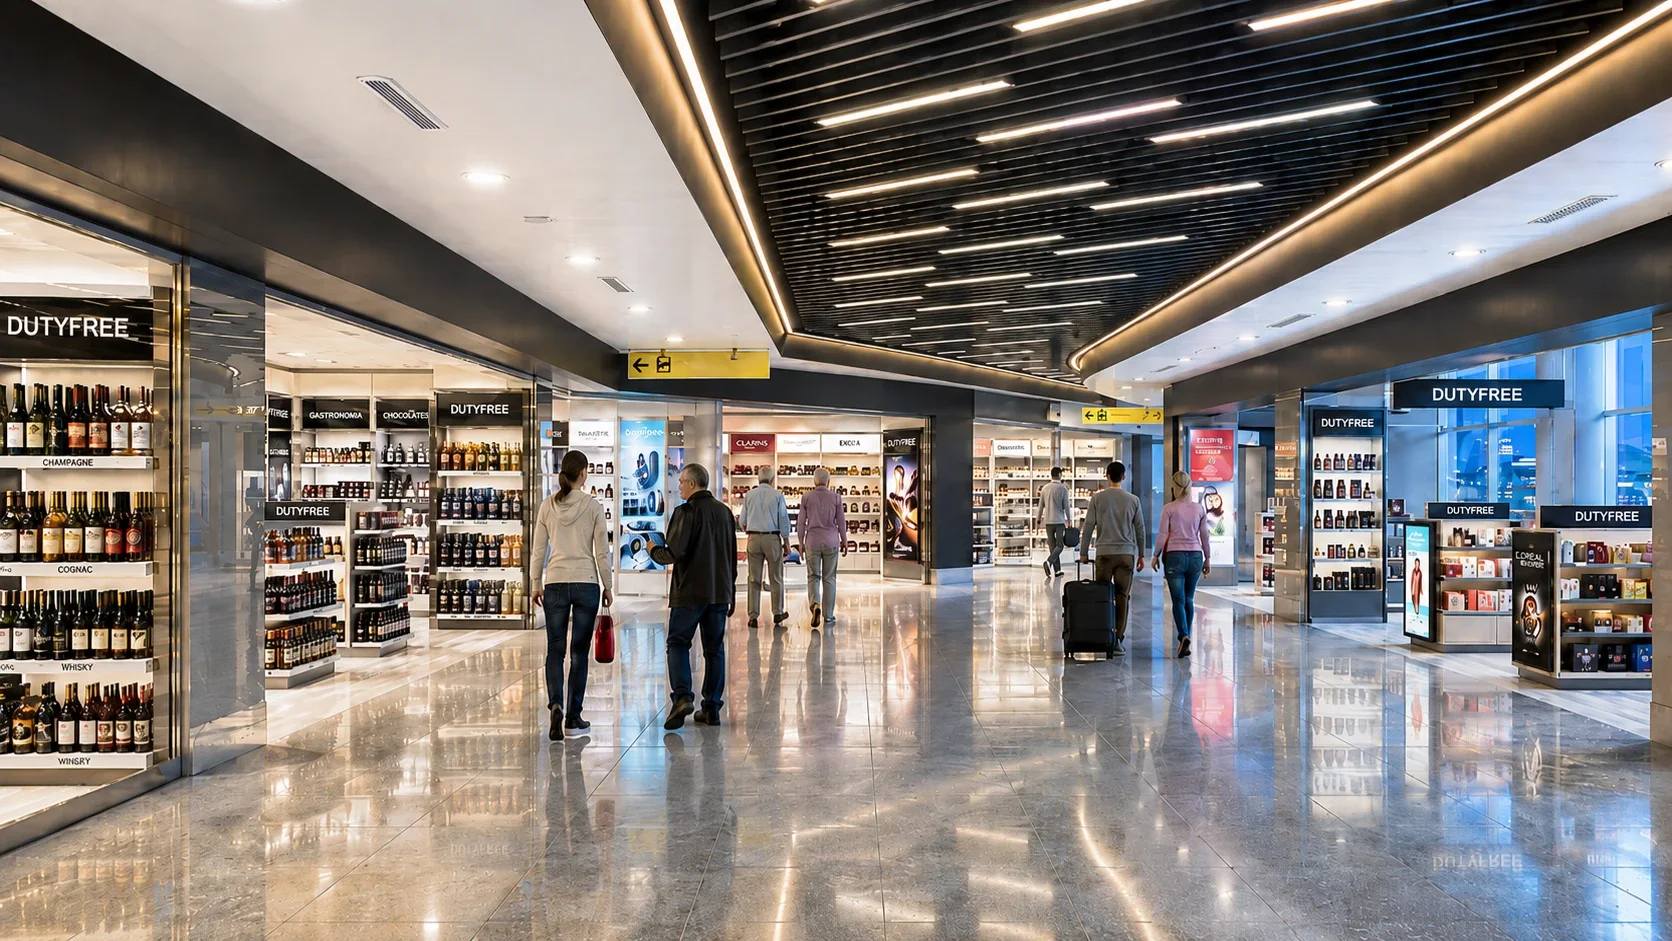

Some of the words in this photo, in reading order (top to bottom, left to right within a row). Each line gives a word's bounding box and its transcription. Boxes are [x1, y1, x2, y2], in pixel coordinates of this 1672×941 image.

[7, 316, 130, 338] DUTYFREE
[1432, 387, 1523, 402] DUTYFREE
[450, 404, 509, 415] DUTYFREE
[1321, 418, 1375, 428] DUTYFREE
[42, 458, 94, 467] CHAMPAGNE
[276, 506, 330, 516] DUTYFREE
[1446, 506, 1494, 515] DUTYFREE
[1575, 510, 1640, 522] DUTYFREE
[57, 565, 94, 574] COGNAC
[60, 663, 94, 672] WHISKY
[57, 757, 91, 766] WINSRY
